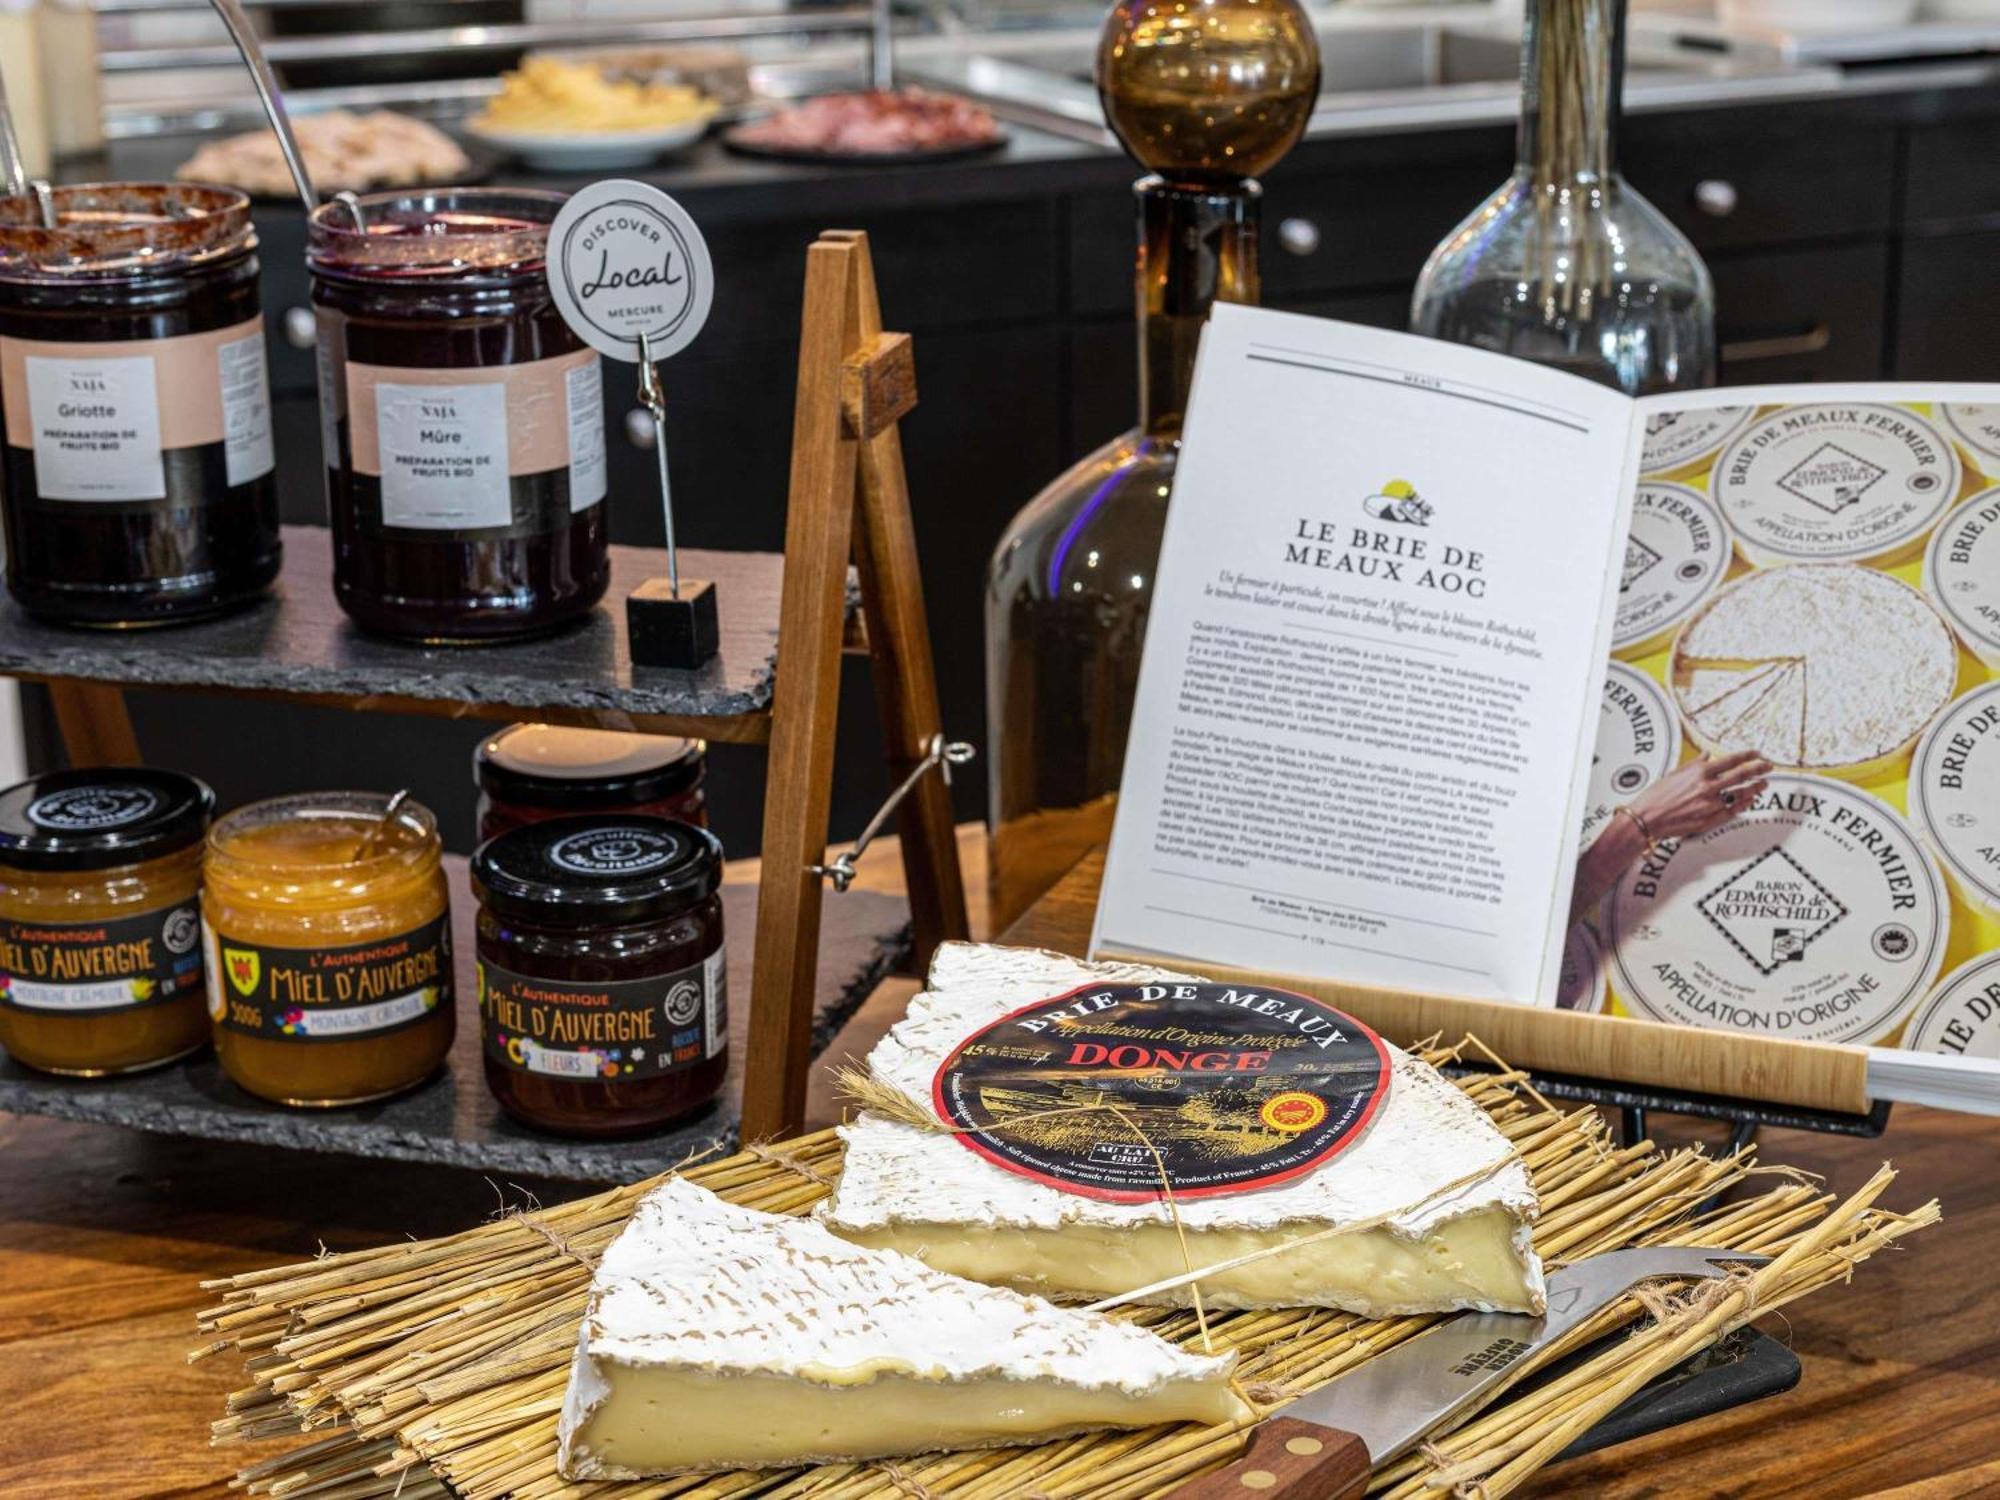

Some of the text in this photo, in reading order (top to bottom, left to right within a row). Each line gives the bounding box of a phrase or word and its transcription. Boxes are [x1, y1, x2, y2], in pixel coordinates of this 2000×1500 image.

[582, 217, 661, 252] DISCOVER
[581, 249, 682, 299] Local
[608, 305, 664, 319] MERCURE
[58, 403, 116, 418] Griotte
[60, 441, 120, 451] FRUITS BIO
[121, 429, 136, 439] DE
[420, 428, 462, 445] Mûre
[1729, 447, 1759, 487] BRIE
[1754, 426, 1781, 449] DE
[1782, 410, 1860, 432] MEAUX
[1864, 413, 1937, 466] FERMIER
[412, 467, 474, 477] FRUITS BIO
[476, 456, 490, 466] DE
[1658, 496, 1712, 553] FERMIER
[1753, 516, 1843, 543] APPELLATION
[1846, 501, 1918, 541] D'ORIGINE
[1297, 518, 1486, 573] LE BRIE DE
[1950, 520, 1985, 566] BRIE
[1283, 544, 1487, 599] MEAUX AOC
[1940, 731, 1976, 790] BRIE
[1633, 791, 1917, 911] BRIE EAUX FERMIER
[1724, 890, 1828, 906] EDMOND de
[1754, 879, 1802, 892] BARON
[1714, 903, 1830, 921] ROTHSCHILD
[31, 938, 156, 980] D'AUVERGNE
[309, 941, 409, 968] L'AUTHENTIQUE
[270, 946, 439, 1003] MIEL D'AUVERGNE
[511, 982, 609, 1006] L'AUTHENTIQUE
[1652, 962, 1771, 1030] APPELLATION
[1776, 972, 1881, 1030] D'ORIGINE
[487, 986, 656, 1042] MIEL D'AUVERGNE
[1017, 985, 1349, 1050] BRIE DE MEAUX
[1052, 1021, 1148, 1041] Appellation
[1150, 1024, 1234, 1048] d'Origine
[540, 1053, 581, 1073] FLEURS
[658, 1052, 672, 1069] EN
[1064, 1042, 1274, 1073] DONGE
[1078, 1171, 1103, 1181] made
[1103, 1174, 1127, 1184] from
[1175, 1174, 1212, 1185] Product
[1212, 1172, 1222, 1181] of
[1222, 1168, 1255, 1180] France
